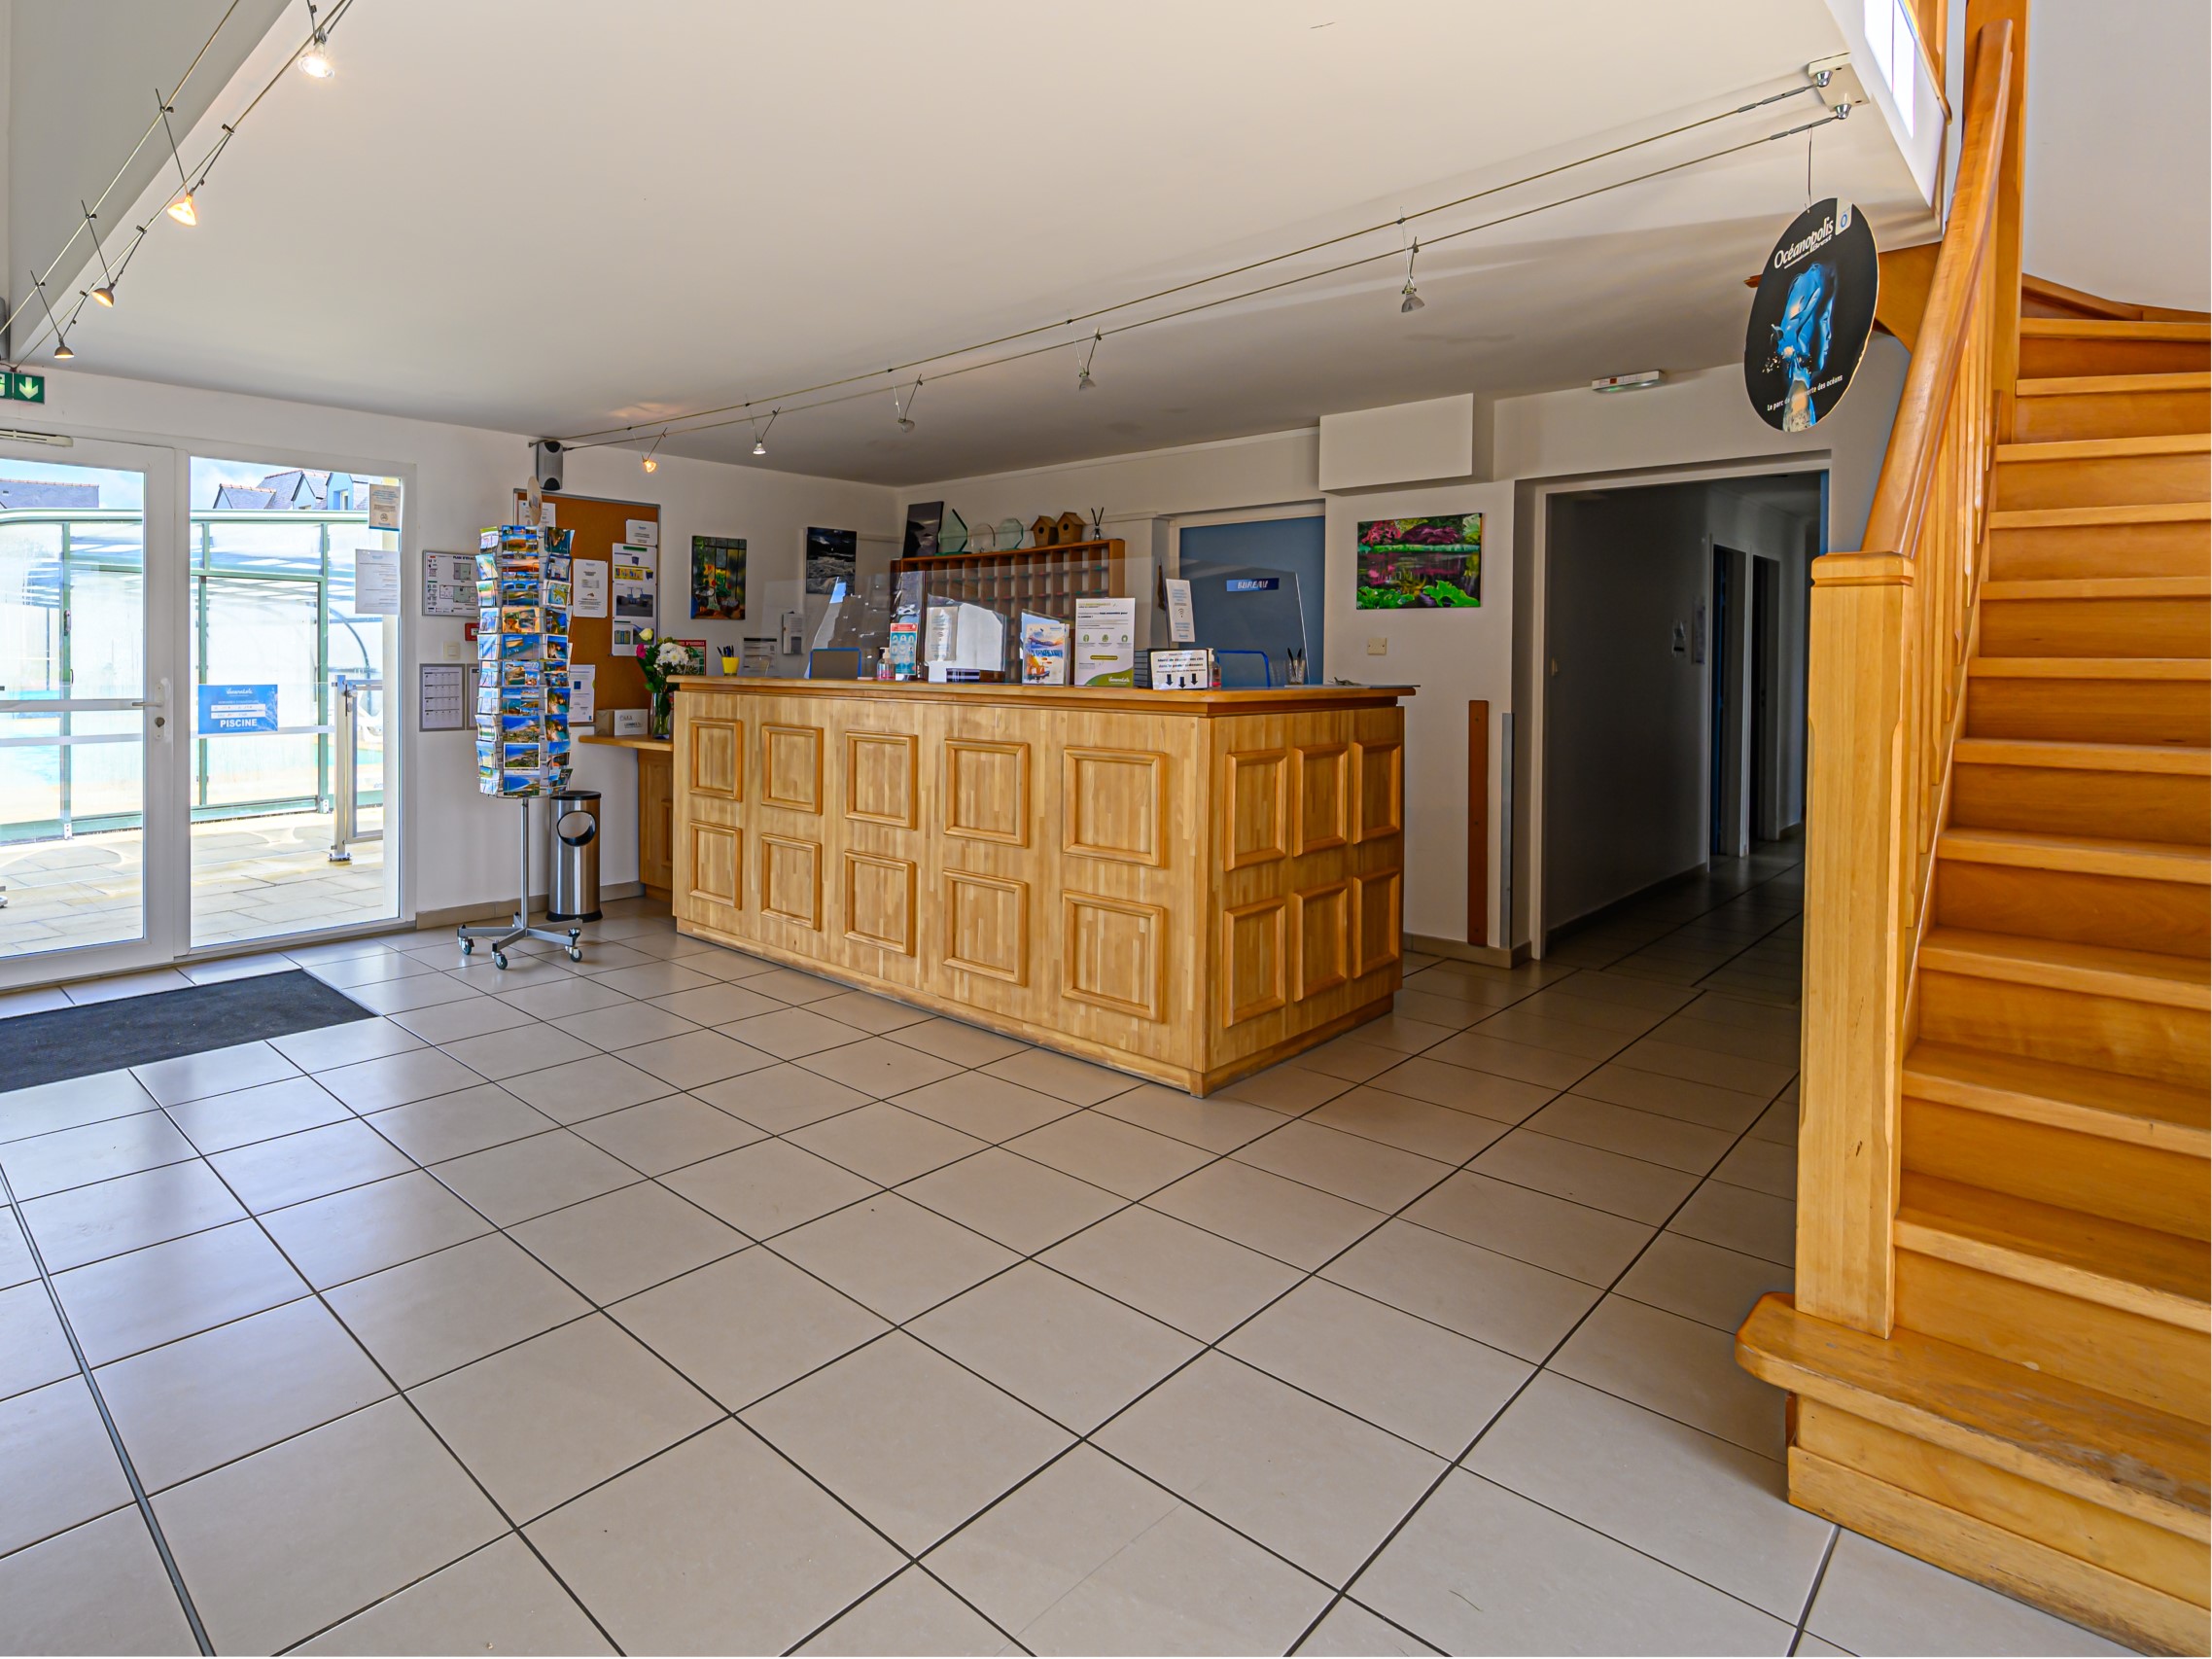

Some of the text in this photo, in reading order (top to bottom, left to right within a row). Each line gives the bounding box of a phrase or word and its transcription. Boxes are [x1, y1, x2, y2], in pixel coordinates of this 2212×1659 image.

[1774, 216, 1834, 268] Océanopolis
[1773, 400, 1784, 411] parc
[1817, 382, 1826, 391] des
[1826, 375, 1843, 387] océans
[1237, 580, 1269, 589] BUREAU
[220, 718, 258, 728] PISCINE
